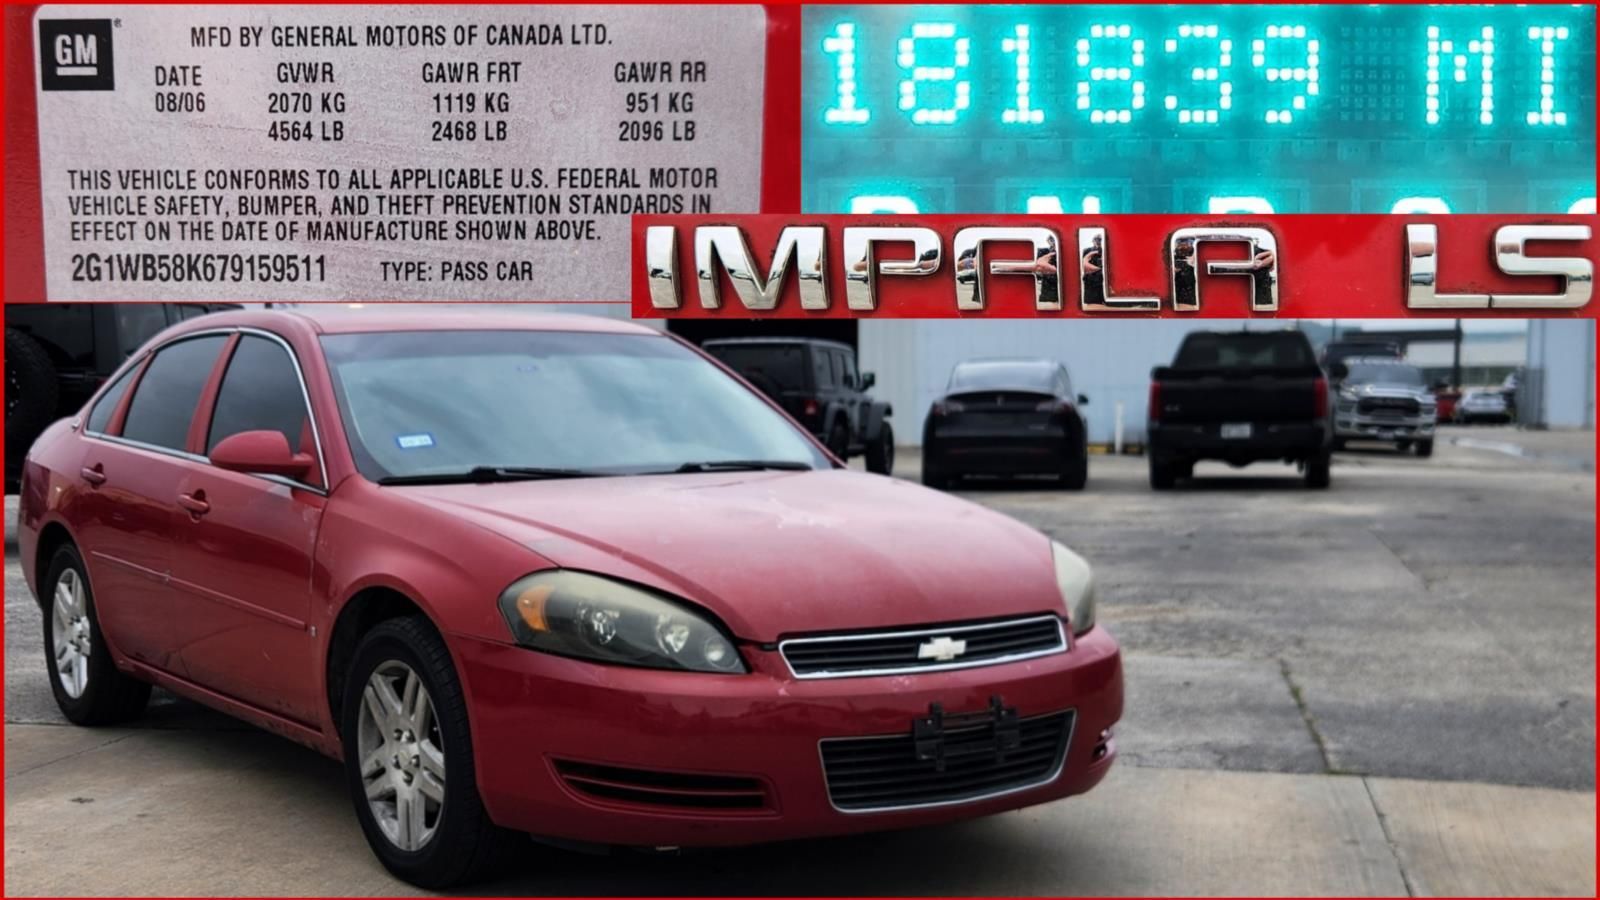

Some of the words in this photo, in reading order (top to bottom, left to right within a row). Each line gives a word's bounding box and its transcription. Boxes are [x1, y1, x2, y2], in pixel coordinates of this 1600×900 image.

[190, 25, 232, 48] MFD
[239, 25, 264, 48] BY
[271, 25, 359, 48] GENERAL
[365, 24, 447, 48] MOTORS
[453, 24, 479, 47] OF
[486, 23, 564, 46] CANADA
[571, 23, 613, 46] LTD.
[54, 33, 98, 66] GM
[154, 64, 203, 87] DATE
[276, 61, 335, 84] GVWR
[421, 61, 480, 84] GAWR
[486, 61, 523, 83] FRT
[613, 60, 673, 84] GAWR
[679, 60, 707, 83] RR
[822, 23, 1320, 126] 181839
[1425, 25, 1570, 125] MI
[154, 91, 206, 113] 08/06
[267, 91, 313, 114] 2070
[321, 91, 346, 114] KG
[432, 91, 476, 114] 1119
[484, 91, 510, 114] KG
[625, 91, 659, 114] 951
[668, 91, 694, 114] KG
[267, 120, 314, 142] 4564
[321, 120, 344, 142] LB
[431, 120, 477, 142] 2468
[484, 119, 508, 142] LB
[618, 120, 664, 142] 2096
[672, 119, 696, 142] LB
[66, 169, 112, 191] THIS
[117, 168, 197, 191] VEHICLE
[204, 168, 310, 191] CONFORMS
[315, 168, 340, 191] TO
[347, 168, 383, 190] ALL
[389, 167, 504, 190] APPLICABLE
[510, 167, 549, 189] U.S.
[557, 167, 641, 189] FEDERAL
[649, 167, 718, 189] MOTOR
[67, 195, 148, 217] VEHICLE
[154, 195, 230, 219] SAFETY,
[238, 195, 323, 218] BUMPER,
[330, 194, 370, 216] AND
[375, 194, 435, 216] THEFT
[442, 193, 561, 215] PREVENTION
[568, 193, 683, 214] STANDARDS
[692, 193, 711, 213] IN
[70, 220, 138, 242] EFFECT
[144, 220, 171, 242] ON
[177, 220, 215, 242] THE
[221, 220, 269, 242] DATE
[274, 220, 300, 242] OF
[306, 220, 449, 242] MANUFACTURE
[455, 219, 527, 241] SHOWN
[534, 219, 601, 241] ABOVE.
[71, 252, 326, 283] 2G1WB58K679159511
[379, 260, 433, 282] TYPE:
[440, 260, 489, 282] PASS
[496, 260, 534, 282] CAR
[647, 224, 1279, 312] IMPALA
[1406, 224, 1592, 310] LS
